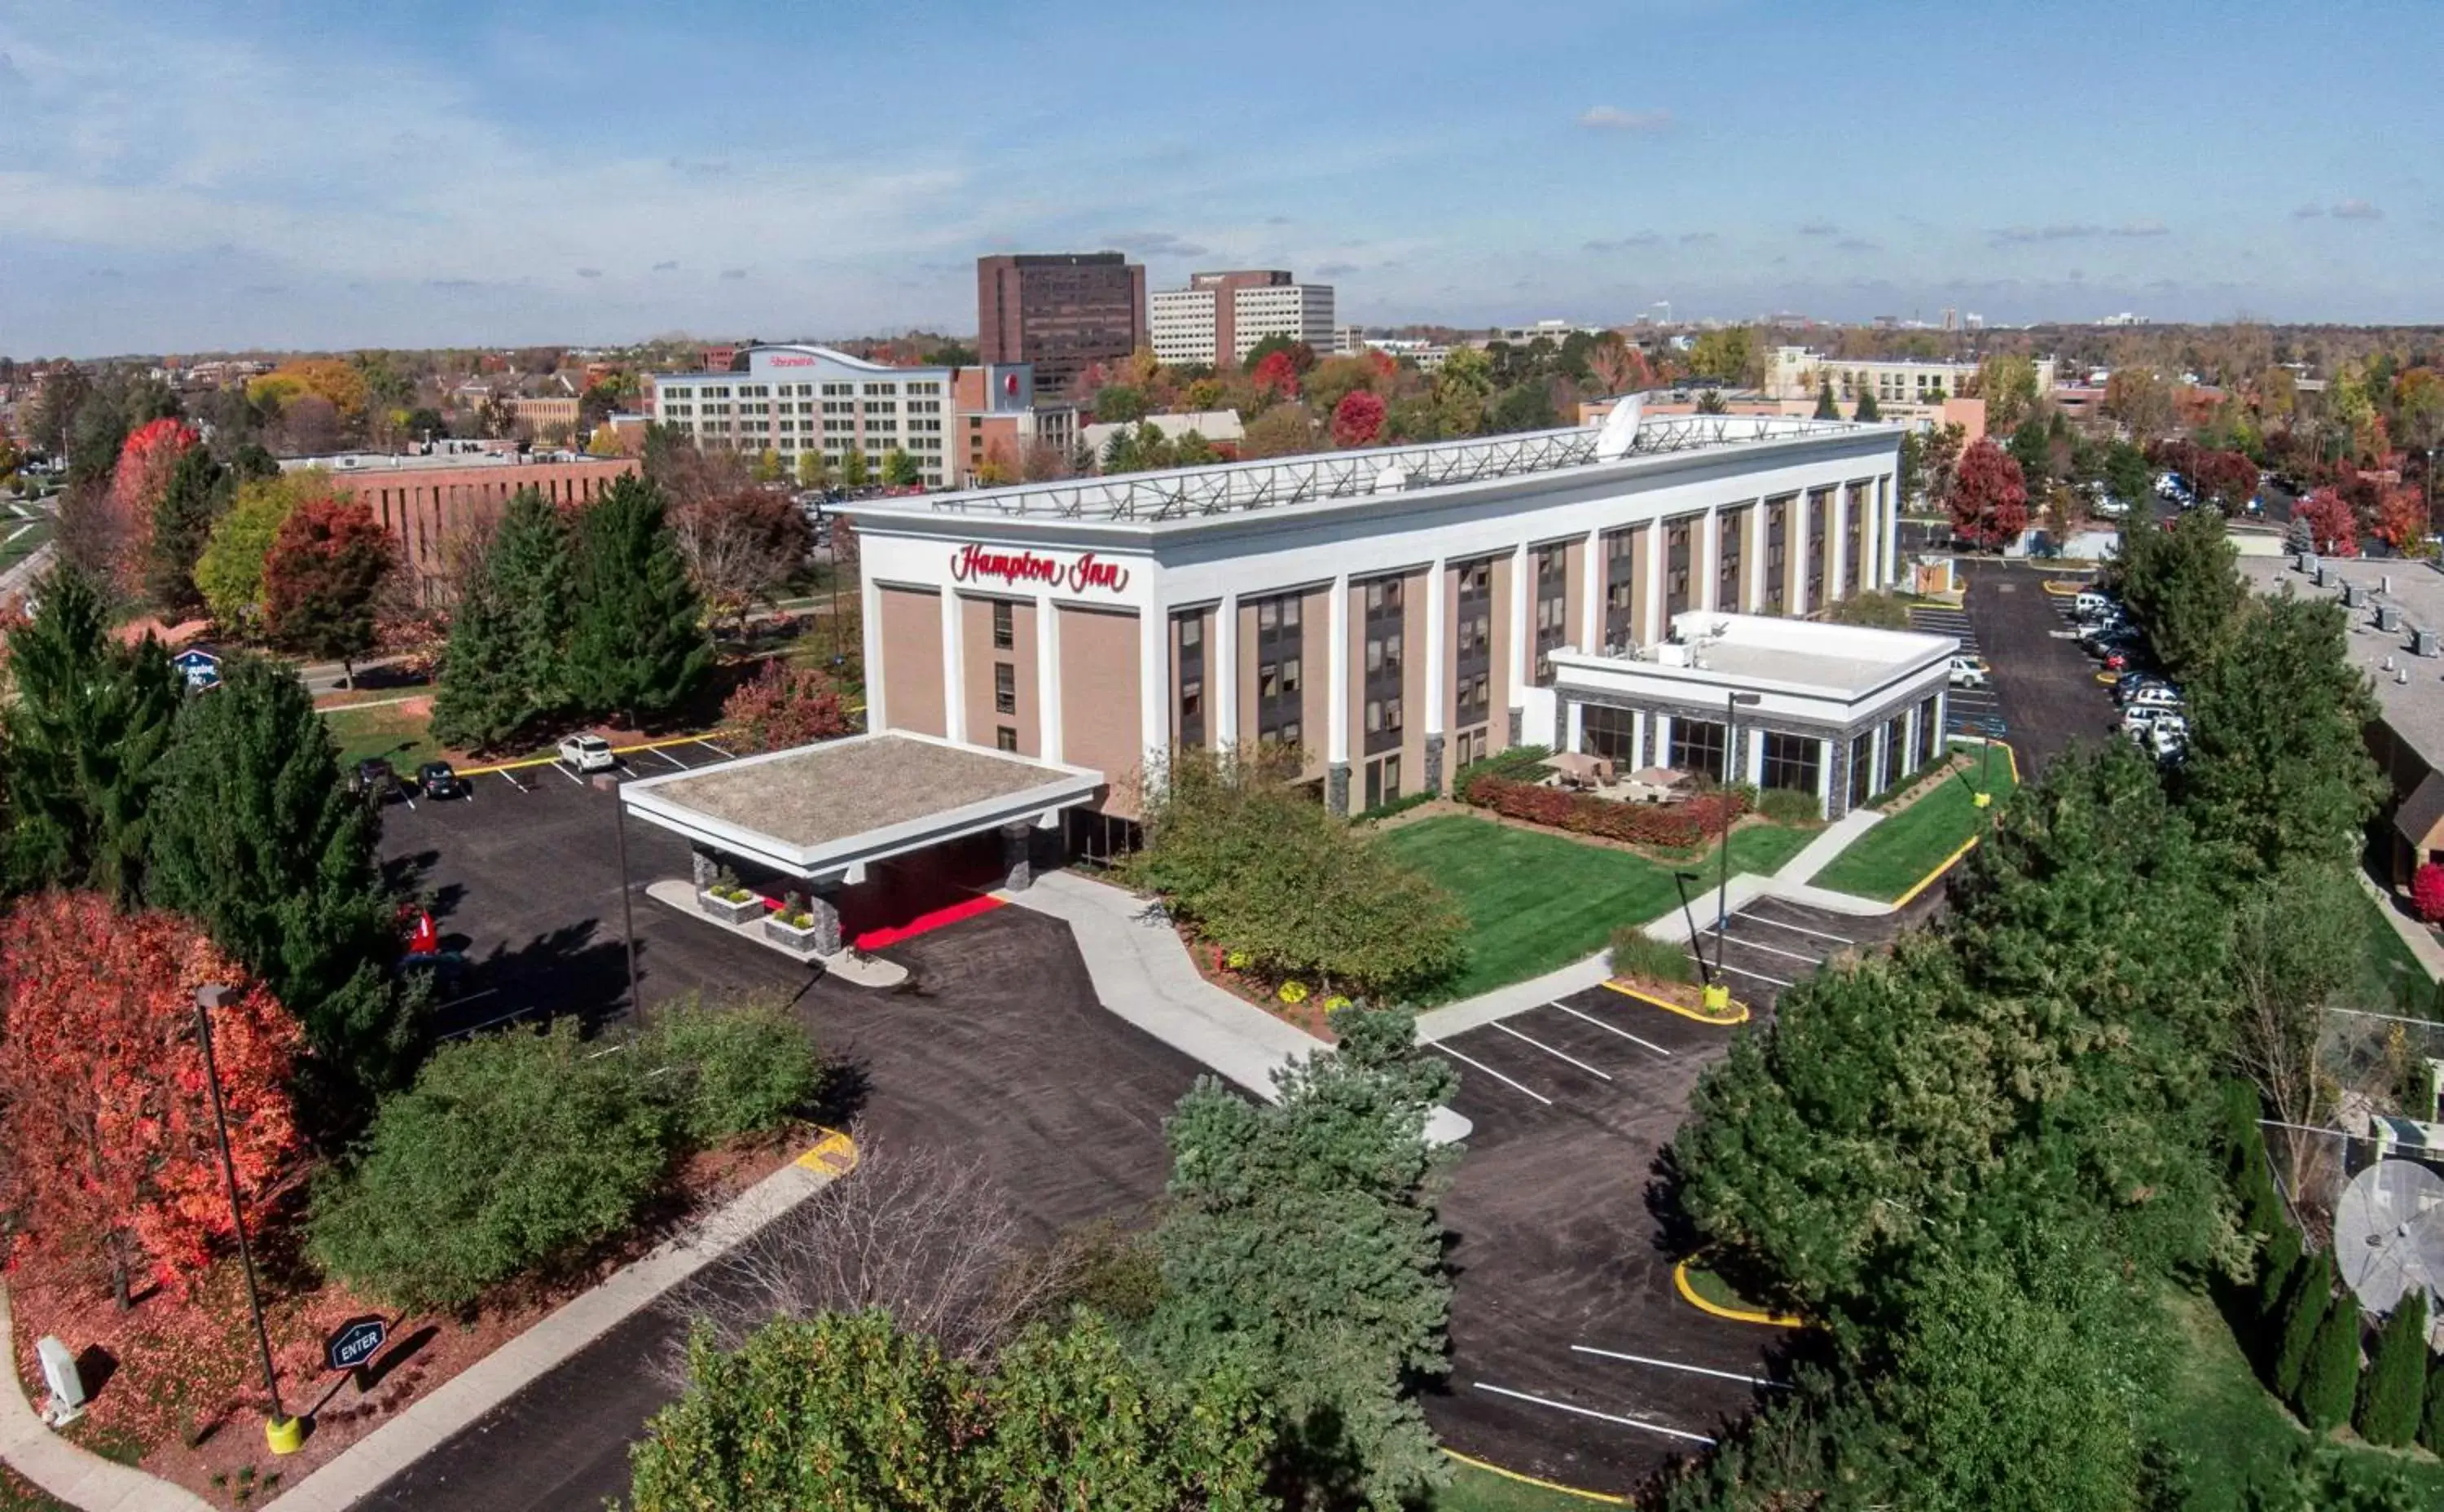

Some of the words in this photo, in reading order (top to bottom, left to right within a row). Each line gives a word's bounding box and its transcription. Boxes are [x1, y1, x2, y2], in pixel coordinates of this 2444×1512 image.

[951, 544, 1066, 587] Hampton
[1068, 551, 1130, 593] Inn
[341, 1332, 378, 1361] ENTER
